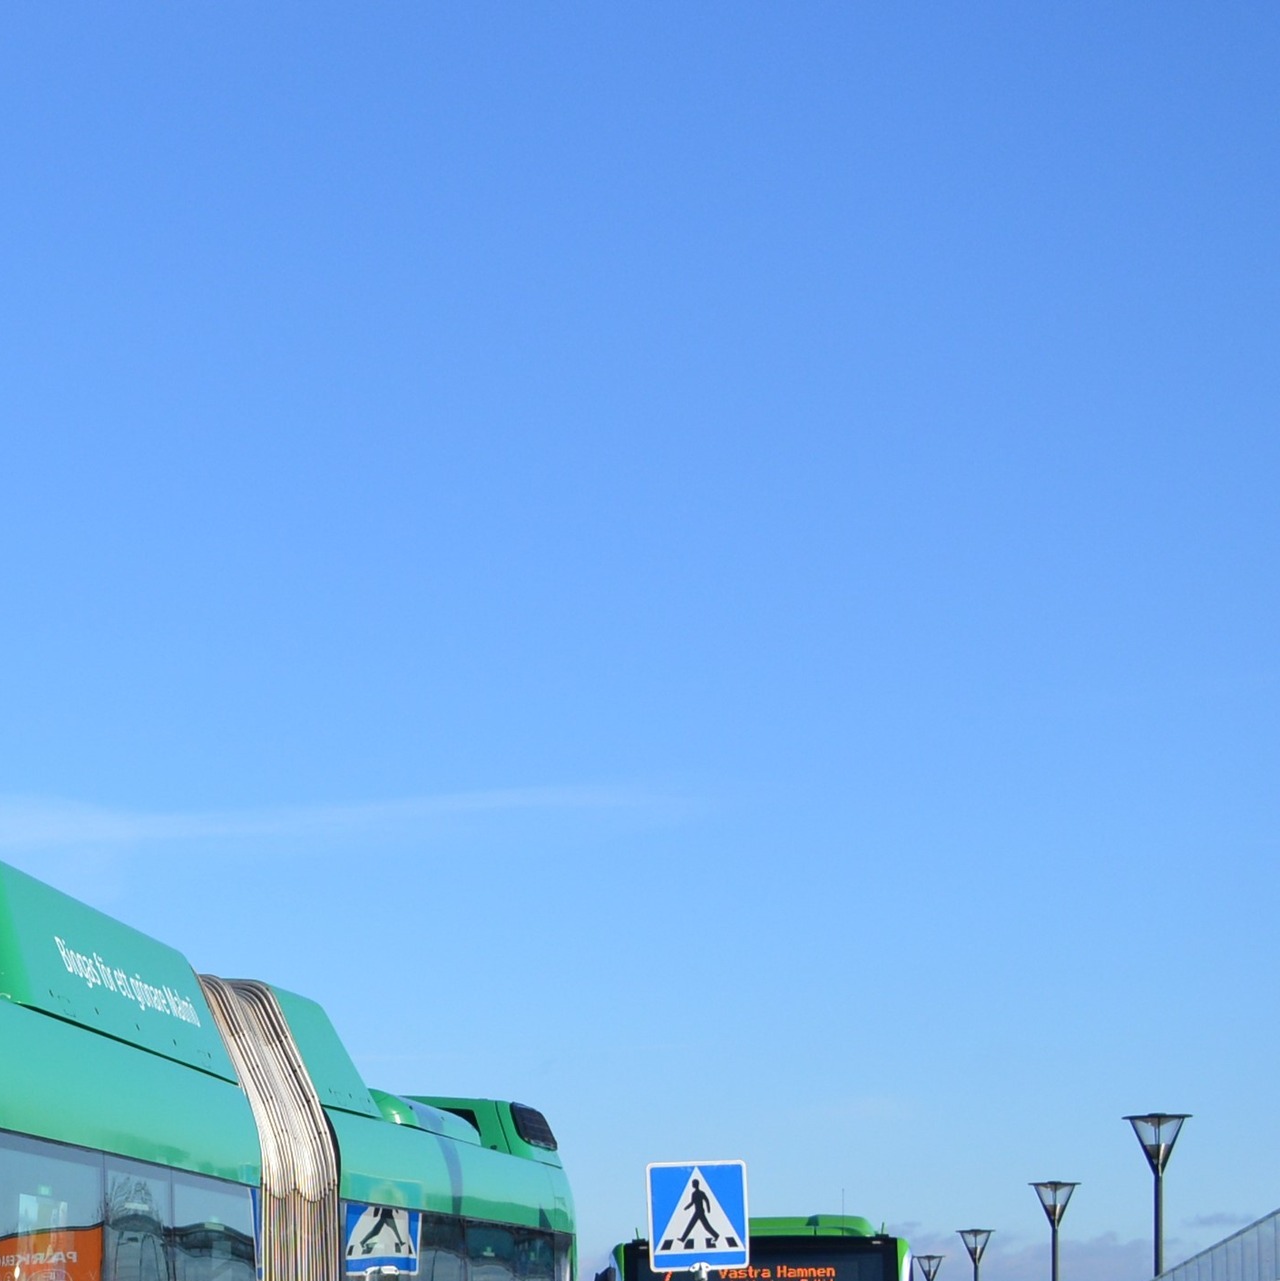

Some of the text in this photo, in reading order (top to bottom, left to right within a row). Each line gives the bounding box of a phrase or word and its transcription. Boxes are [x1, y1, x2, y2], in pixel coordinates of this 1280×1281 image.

[54, 936, 101, 989] Biogas
[93, 952, 118, 993] för
[114, 968, 135, 1001] ett
[776, 1266, 836, 1279] Hamnen
